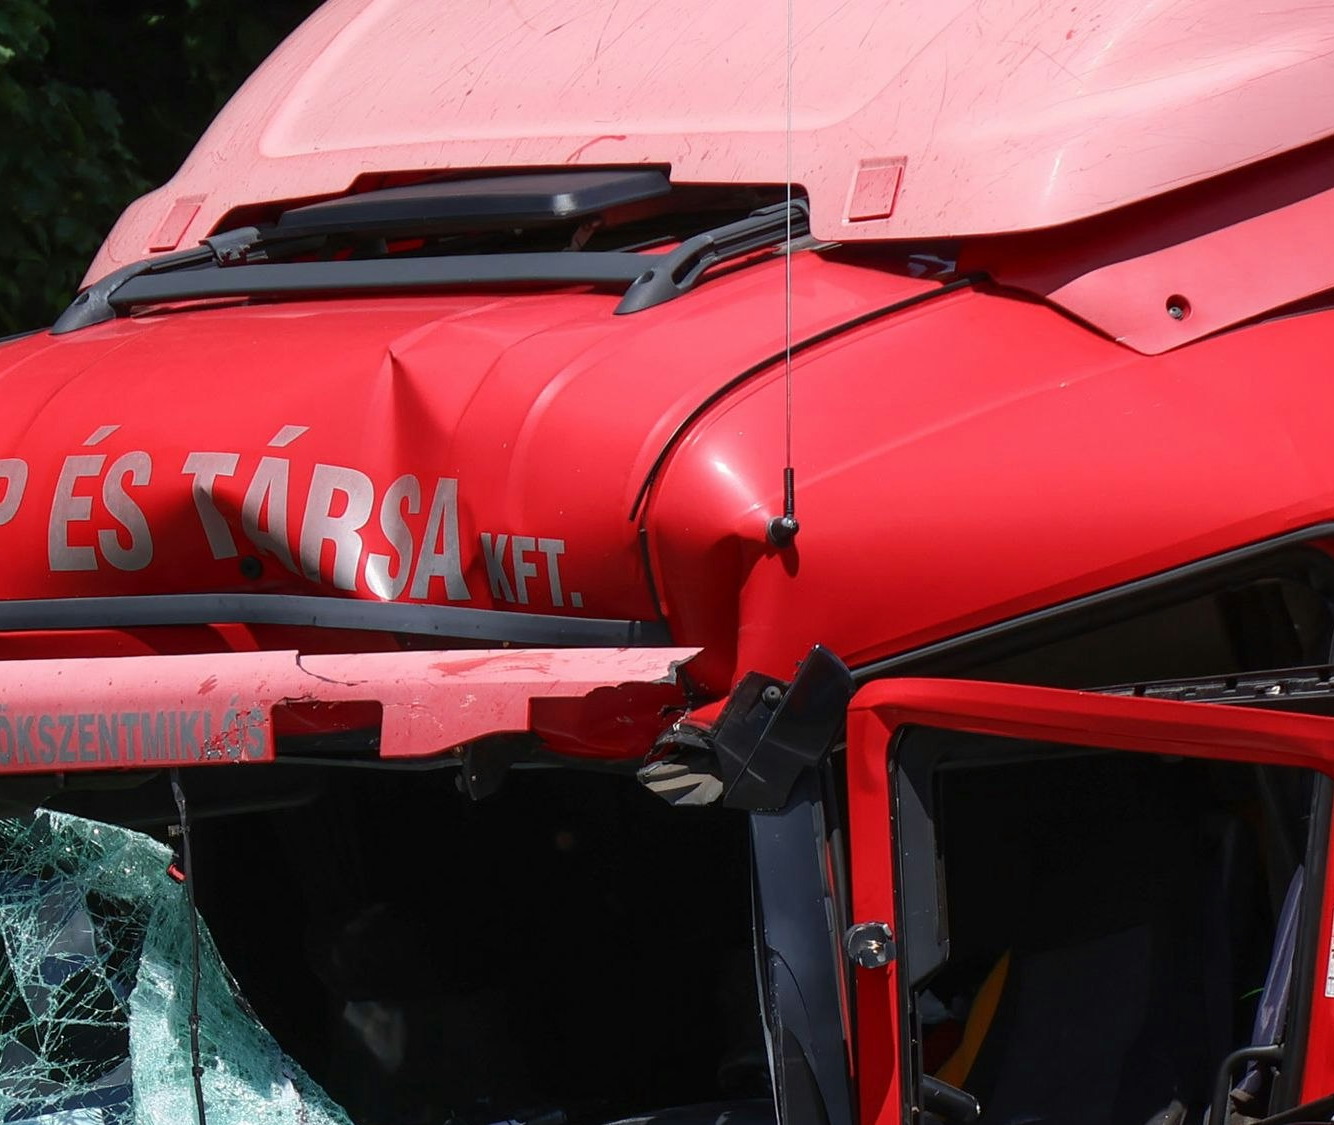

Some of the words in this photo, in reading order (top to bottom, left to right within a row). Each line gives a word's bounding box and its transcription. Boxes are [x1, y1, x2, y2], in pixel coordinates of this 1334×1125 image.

[48, 424, 153, 572] ÉS
[181, 424, 471, 602] TÁRSA
[480, 531, 584, 609] KFT.
